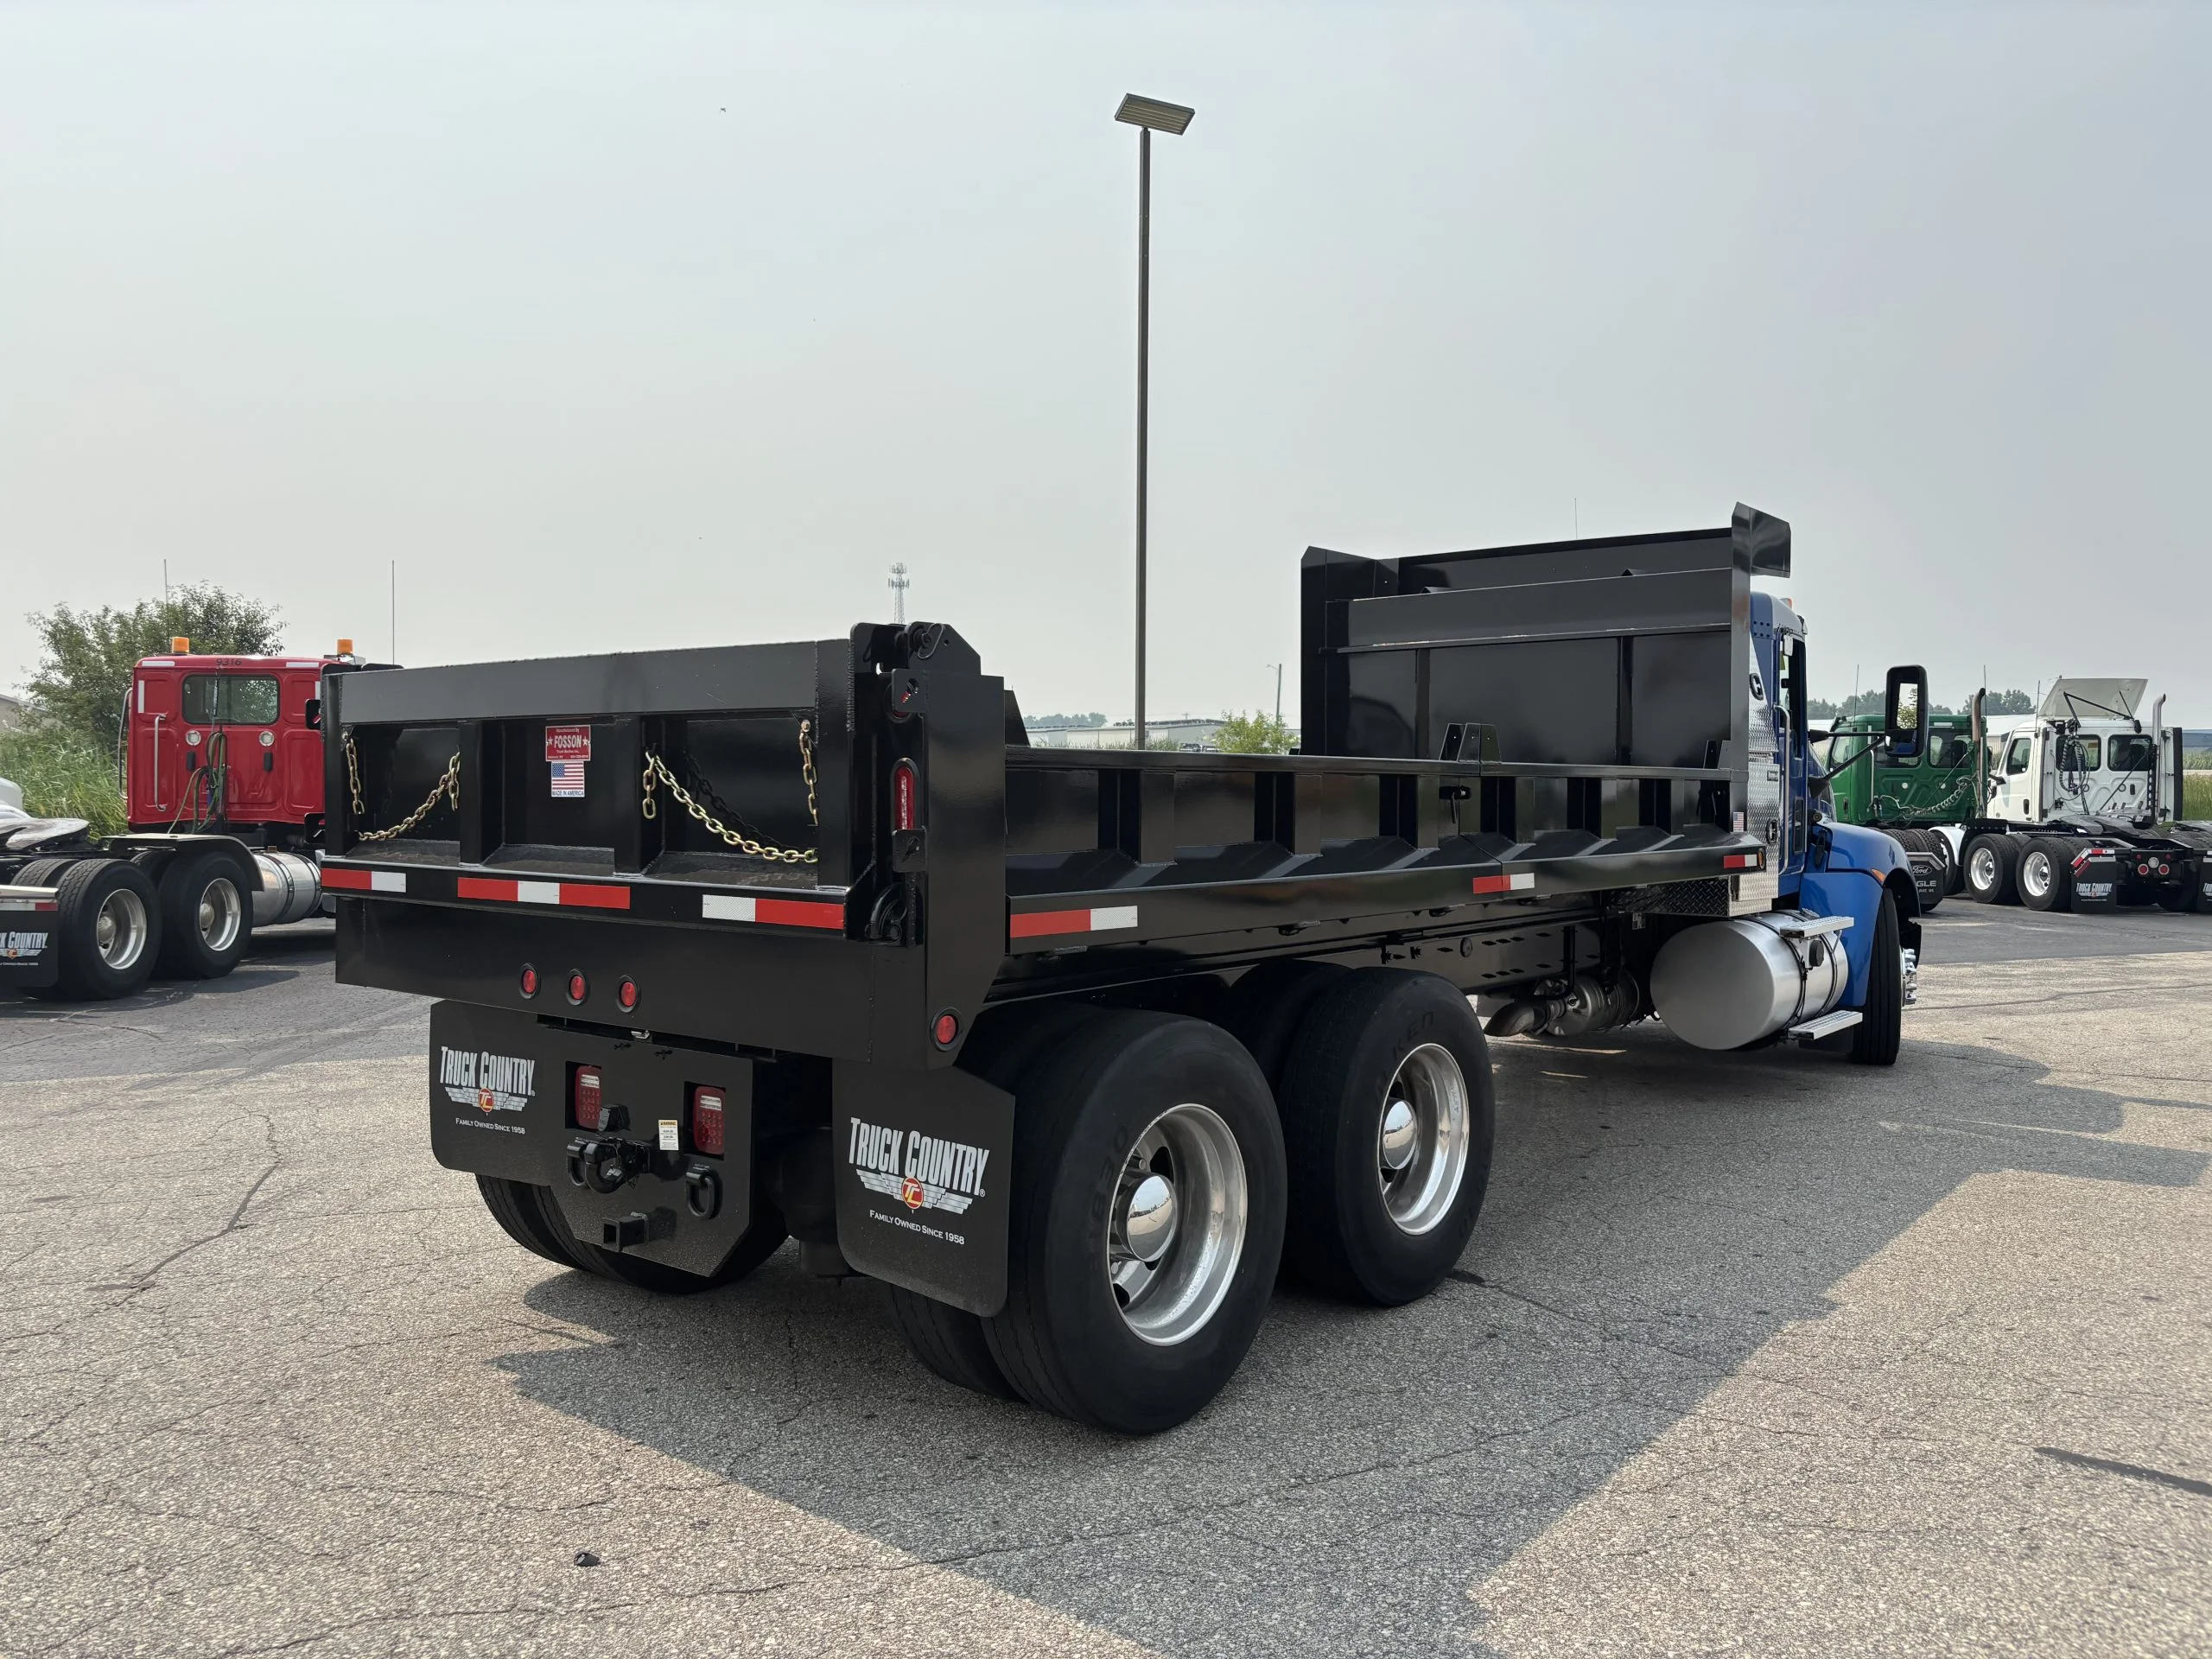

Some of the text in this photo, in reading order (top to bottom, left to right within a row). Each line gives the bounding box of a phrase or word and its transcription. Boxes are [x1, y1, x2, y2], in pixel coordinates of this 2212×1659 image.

[216, 658, 242, 666] 9316
[554, 734, 582, 748] FOSSON
[1912, 865, 1929, 874] Ford
[8, 931, 48, 949] COUNTRY
[440, 1046, 535, 1096] TRUCK COUNTRY
[455, 1117, 525, 1135] FAMILY OWNED SINCE 1958
[849, 1116, 990, 1196] TRUCK COUNTRY
[869, 1209, 965, 1245] FAMILY OWNED SINCE 1958
